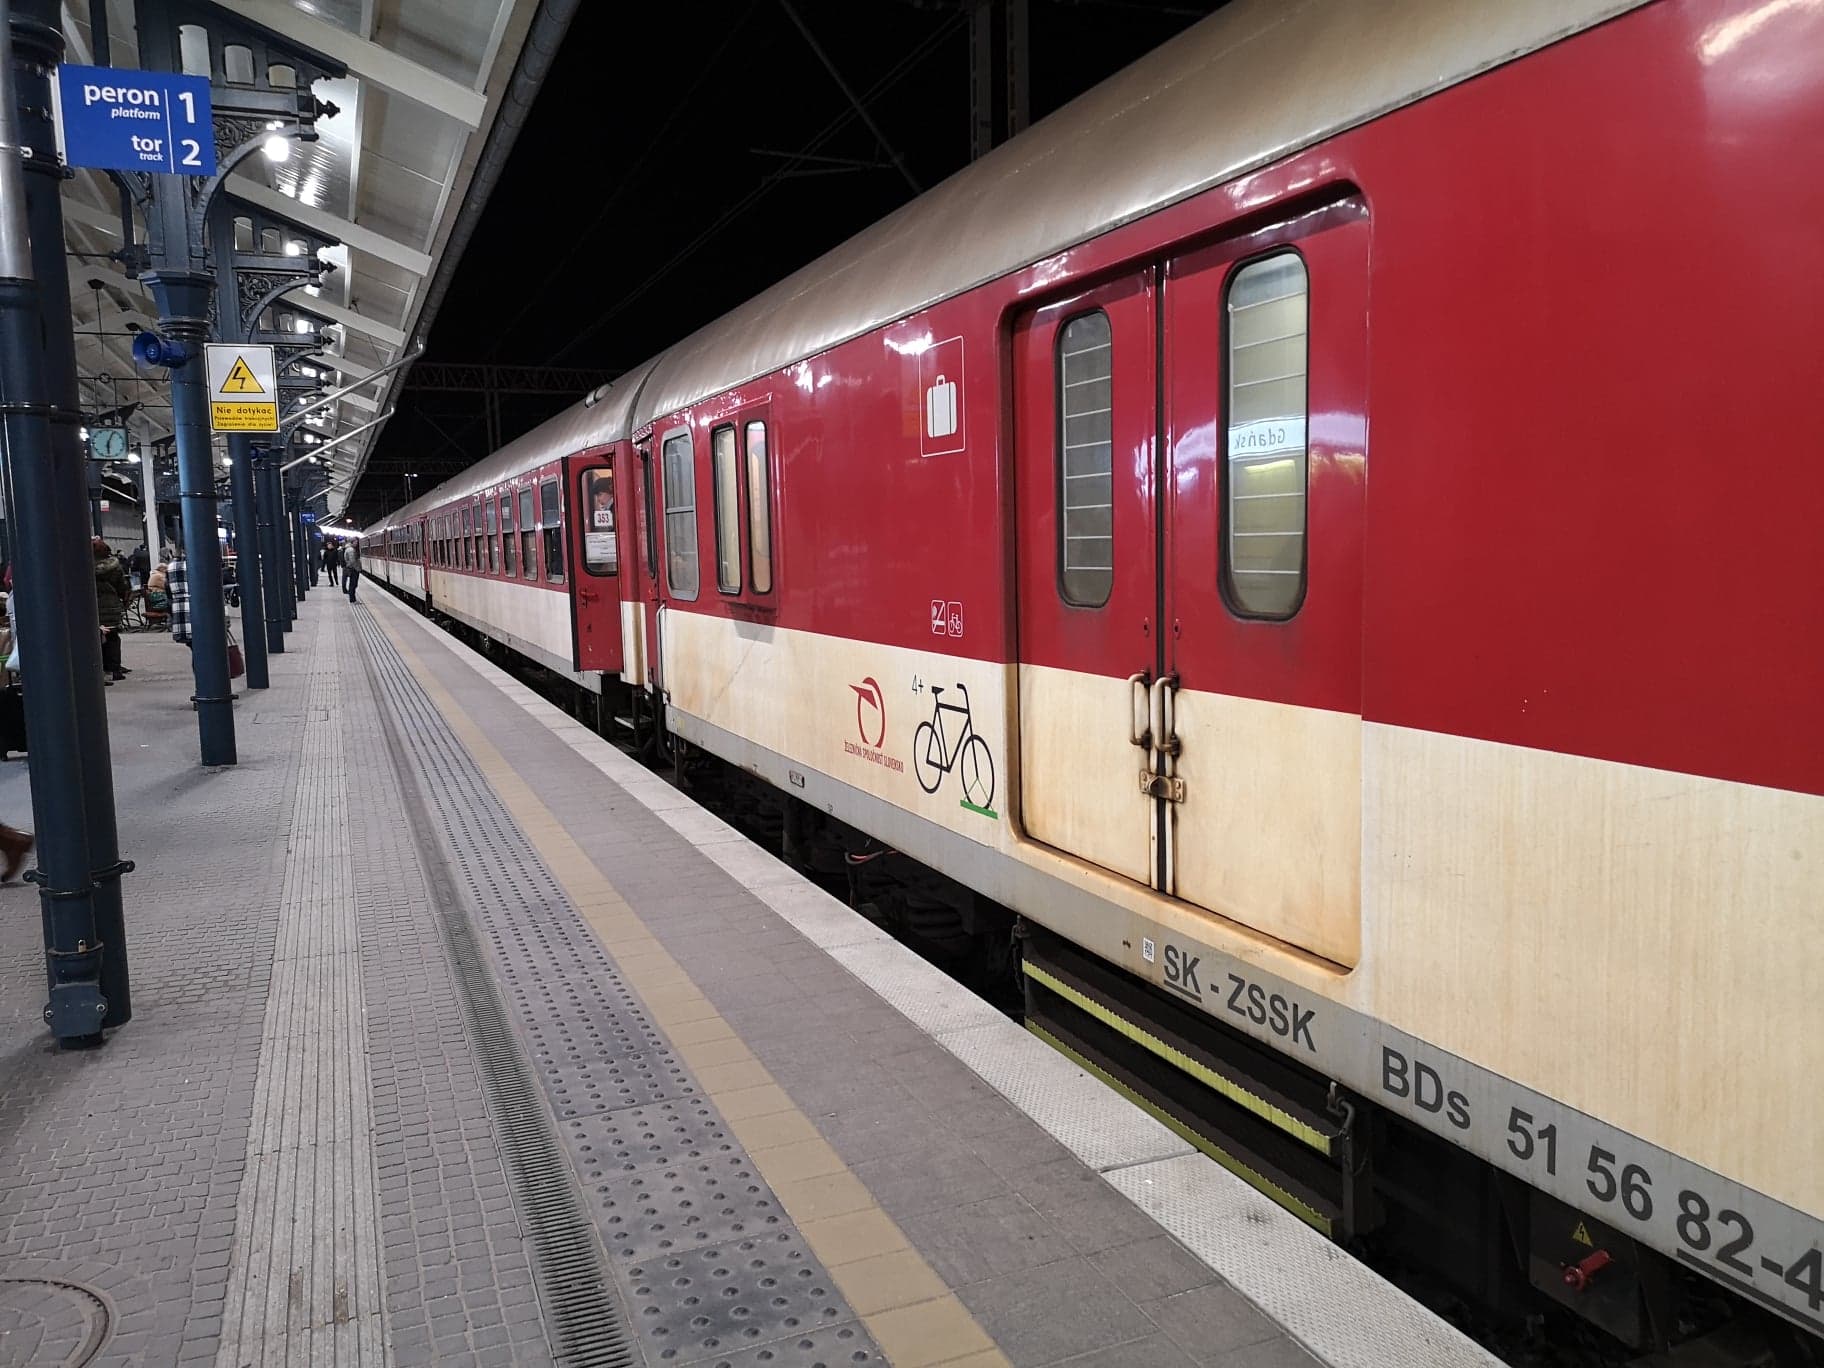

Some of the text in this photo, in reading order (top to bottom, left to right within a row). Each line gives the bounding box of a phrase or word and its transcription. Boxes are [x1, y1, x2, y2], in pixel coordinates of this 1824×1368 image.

[83, 84, 196, 124] peron 1
[111, 106, 161, 120] platform
[131, 134, 202, 166] tor 2
[139, 152, 164, 162] track
[216, 406, 232, 414] Nie
[911, 673, 924, 695] 4+
[1163, 944, 1202, 994] SK
[1227, 973, 1317, 1052] ZSSK
[1382, 1046, 1472, 1130] BDs
[1507, 1106, 1558, 1176] 51
[1586, 1144, 1654, 1222] 56
